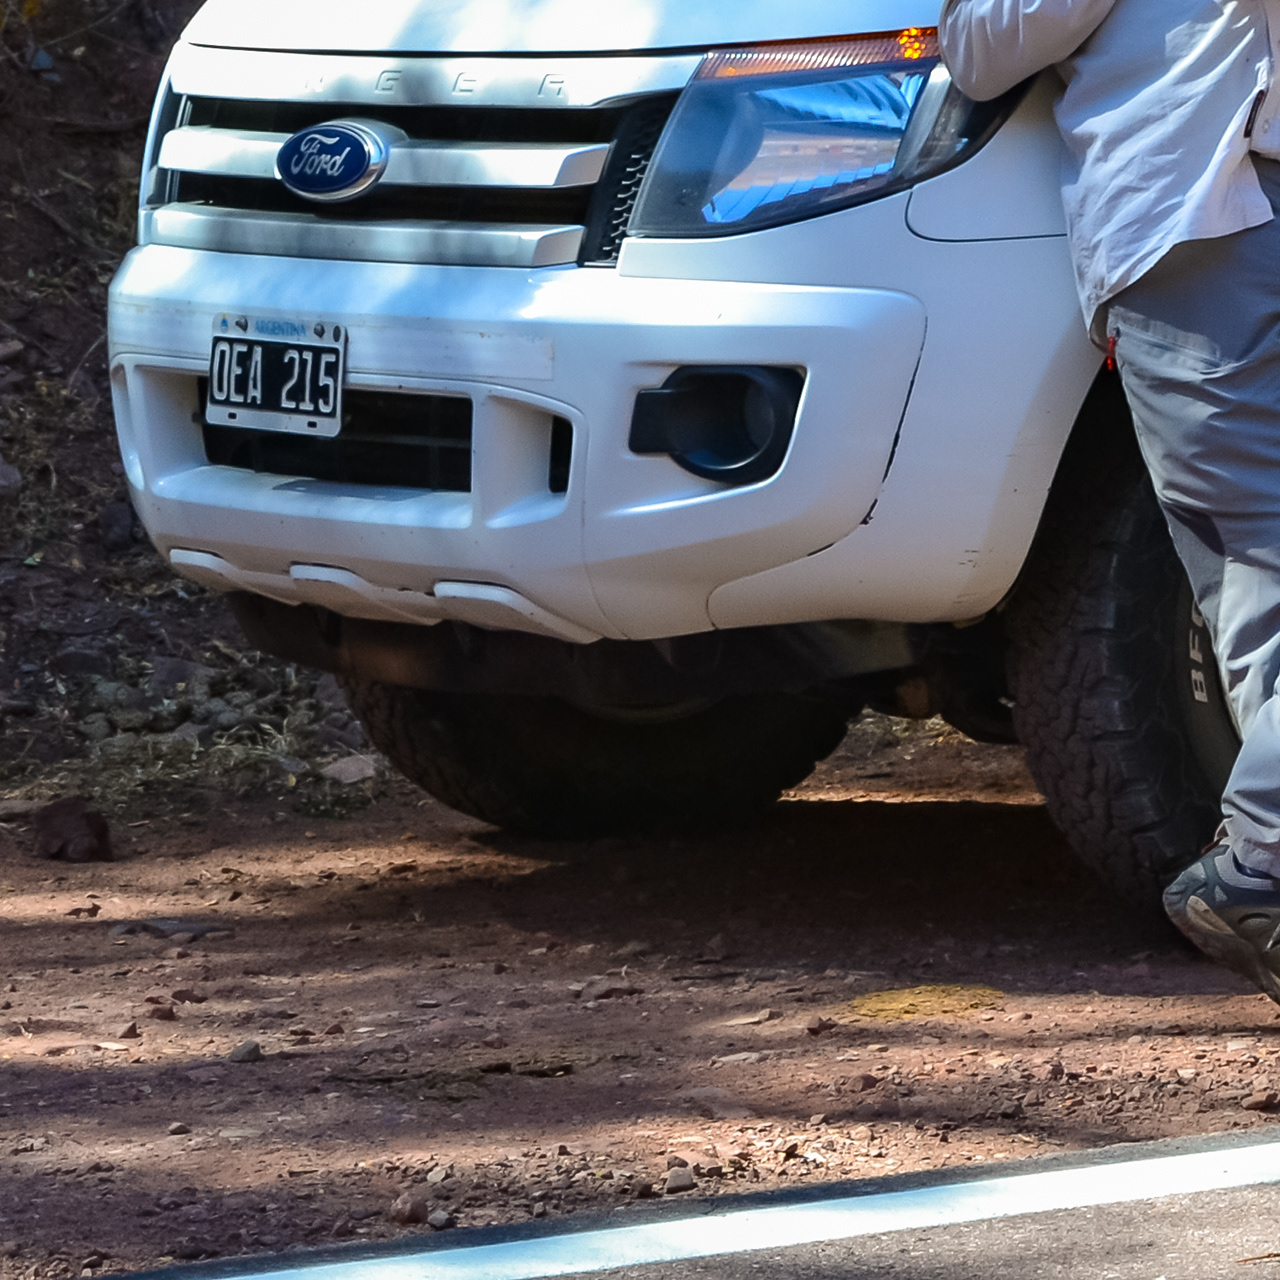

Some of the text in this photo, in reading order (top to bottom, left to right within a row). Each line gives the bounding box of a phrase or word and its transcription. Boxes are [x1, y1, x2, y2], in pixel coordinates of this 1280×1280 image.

[291, 133, 351, 176] Ford
[255, 320, 307, 337] ARGENTINA
[212, 341, 337, 414] OEA 215
